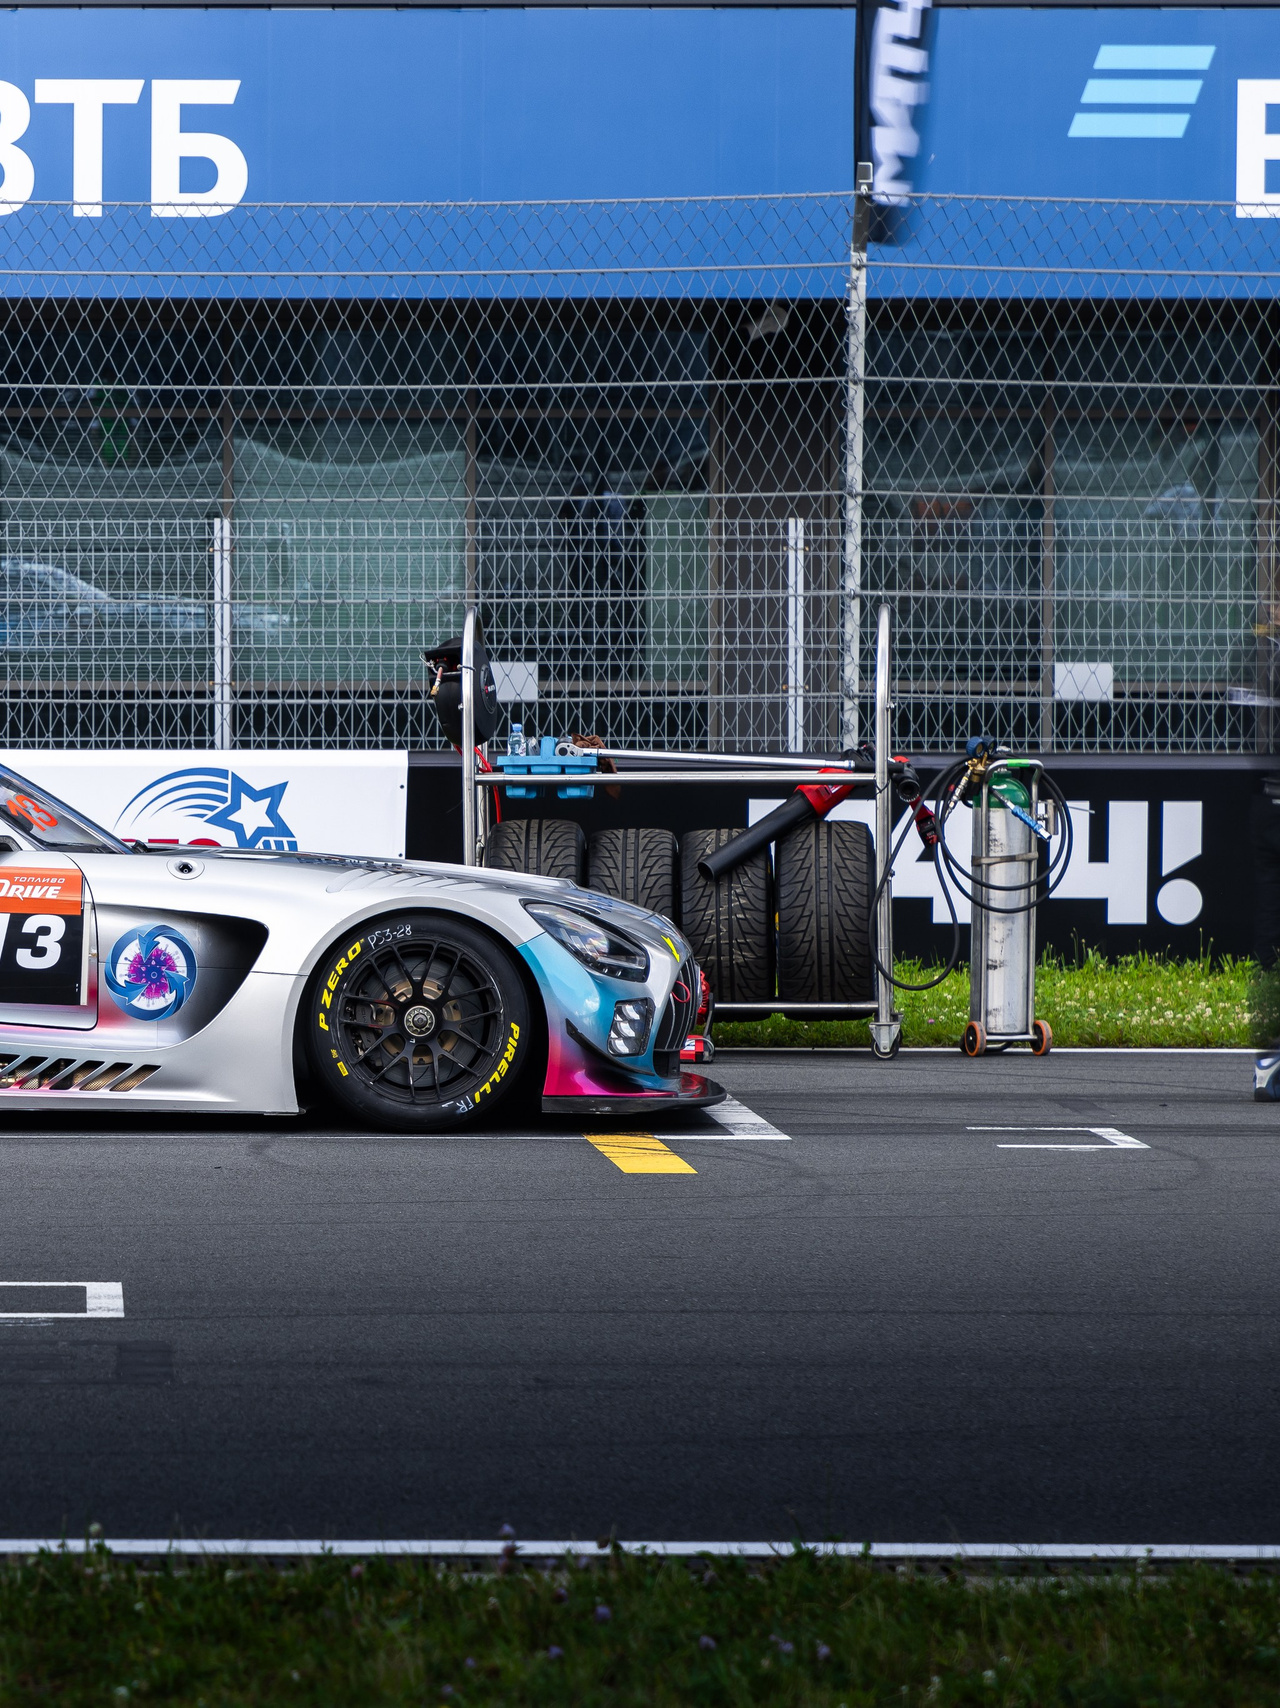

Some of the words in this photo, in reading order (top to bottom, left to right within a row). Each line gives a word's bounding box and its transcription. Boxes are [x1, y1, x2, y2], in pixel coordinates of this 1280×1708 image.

[6, 794, 58, 832] 13
[14, 876, 66, 884] ТОПЛИВО
[367, 924, 412, 950] PS3-28
[474, 1021, 520, 1103] PIRELLI
